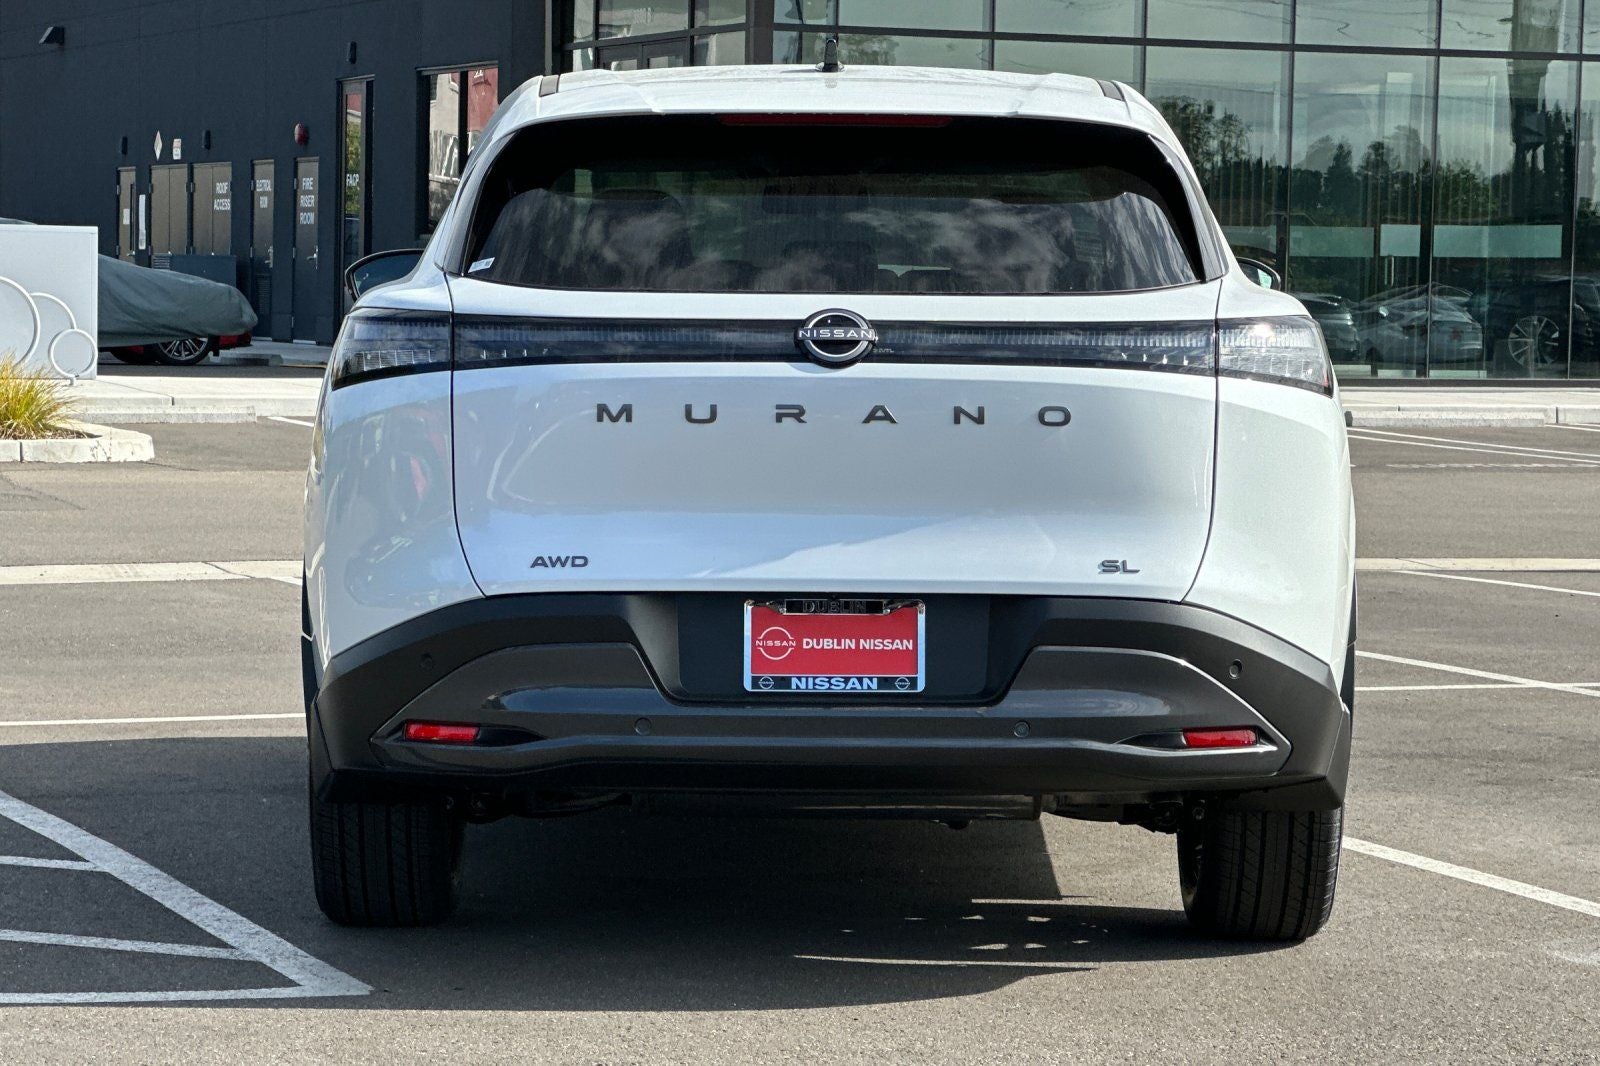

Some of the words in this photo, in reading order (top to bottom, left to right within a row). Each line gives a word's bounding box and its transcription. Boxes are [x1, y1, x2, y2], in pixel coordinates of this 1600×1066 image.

[216, 182, 228, 194] ROOF
[302, 177, 314, 190] FIRE
[214, 199, 231, 210] ACCESS
[300, 195, 315, 207] RISER
[300, 213, 315, 225] ROOM
[799, 329, 873, 338] NISSAN
[596, 403, 1072, 427] MURANO
[530, 555, 589, 568] AWD
[1099, 559, 1141, 574] SL
[803, 600, 866, 613] DUBLIN
[802, 638, 856, 650] DUBLIN
[859, 639, 913, 650] NISSAN
[791, 677, 877, 690] NISSAN
